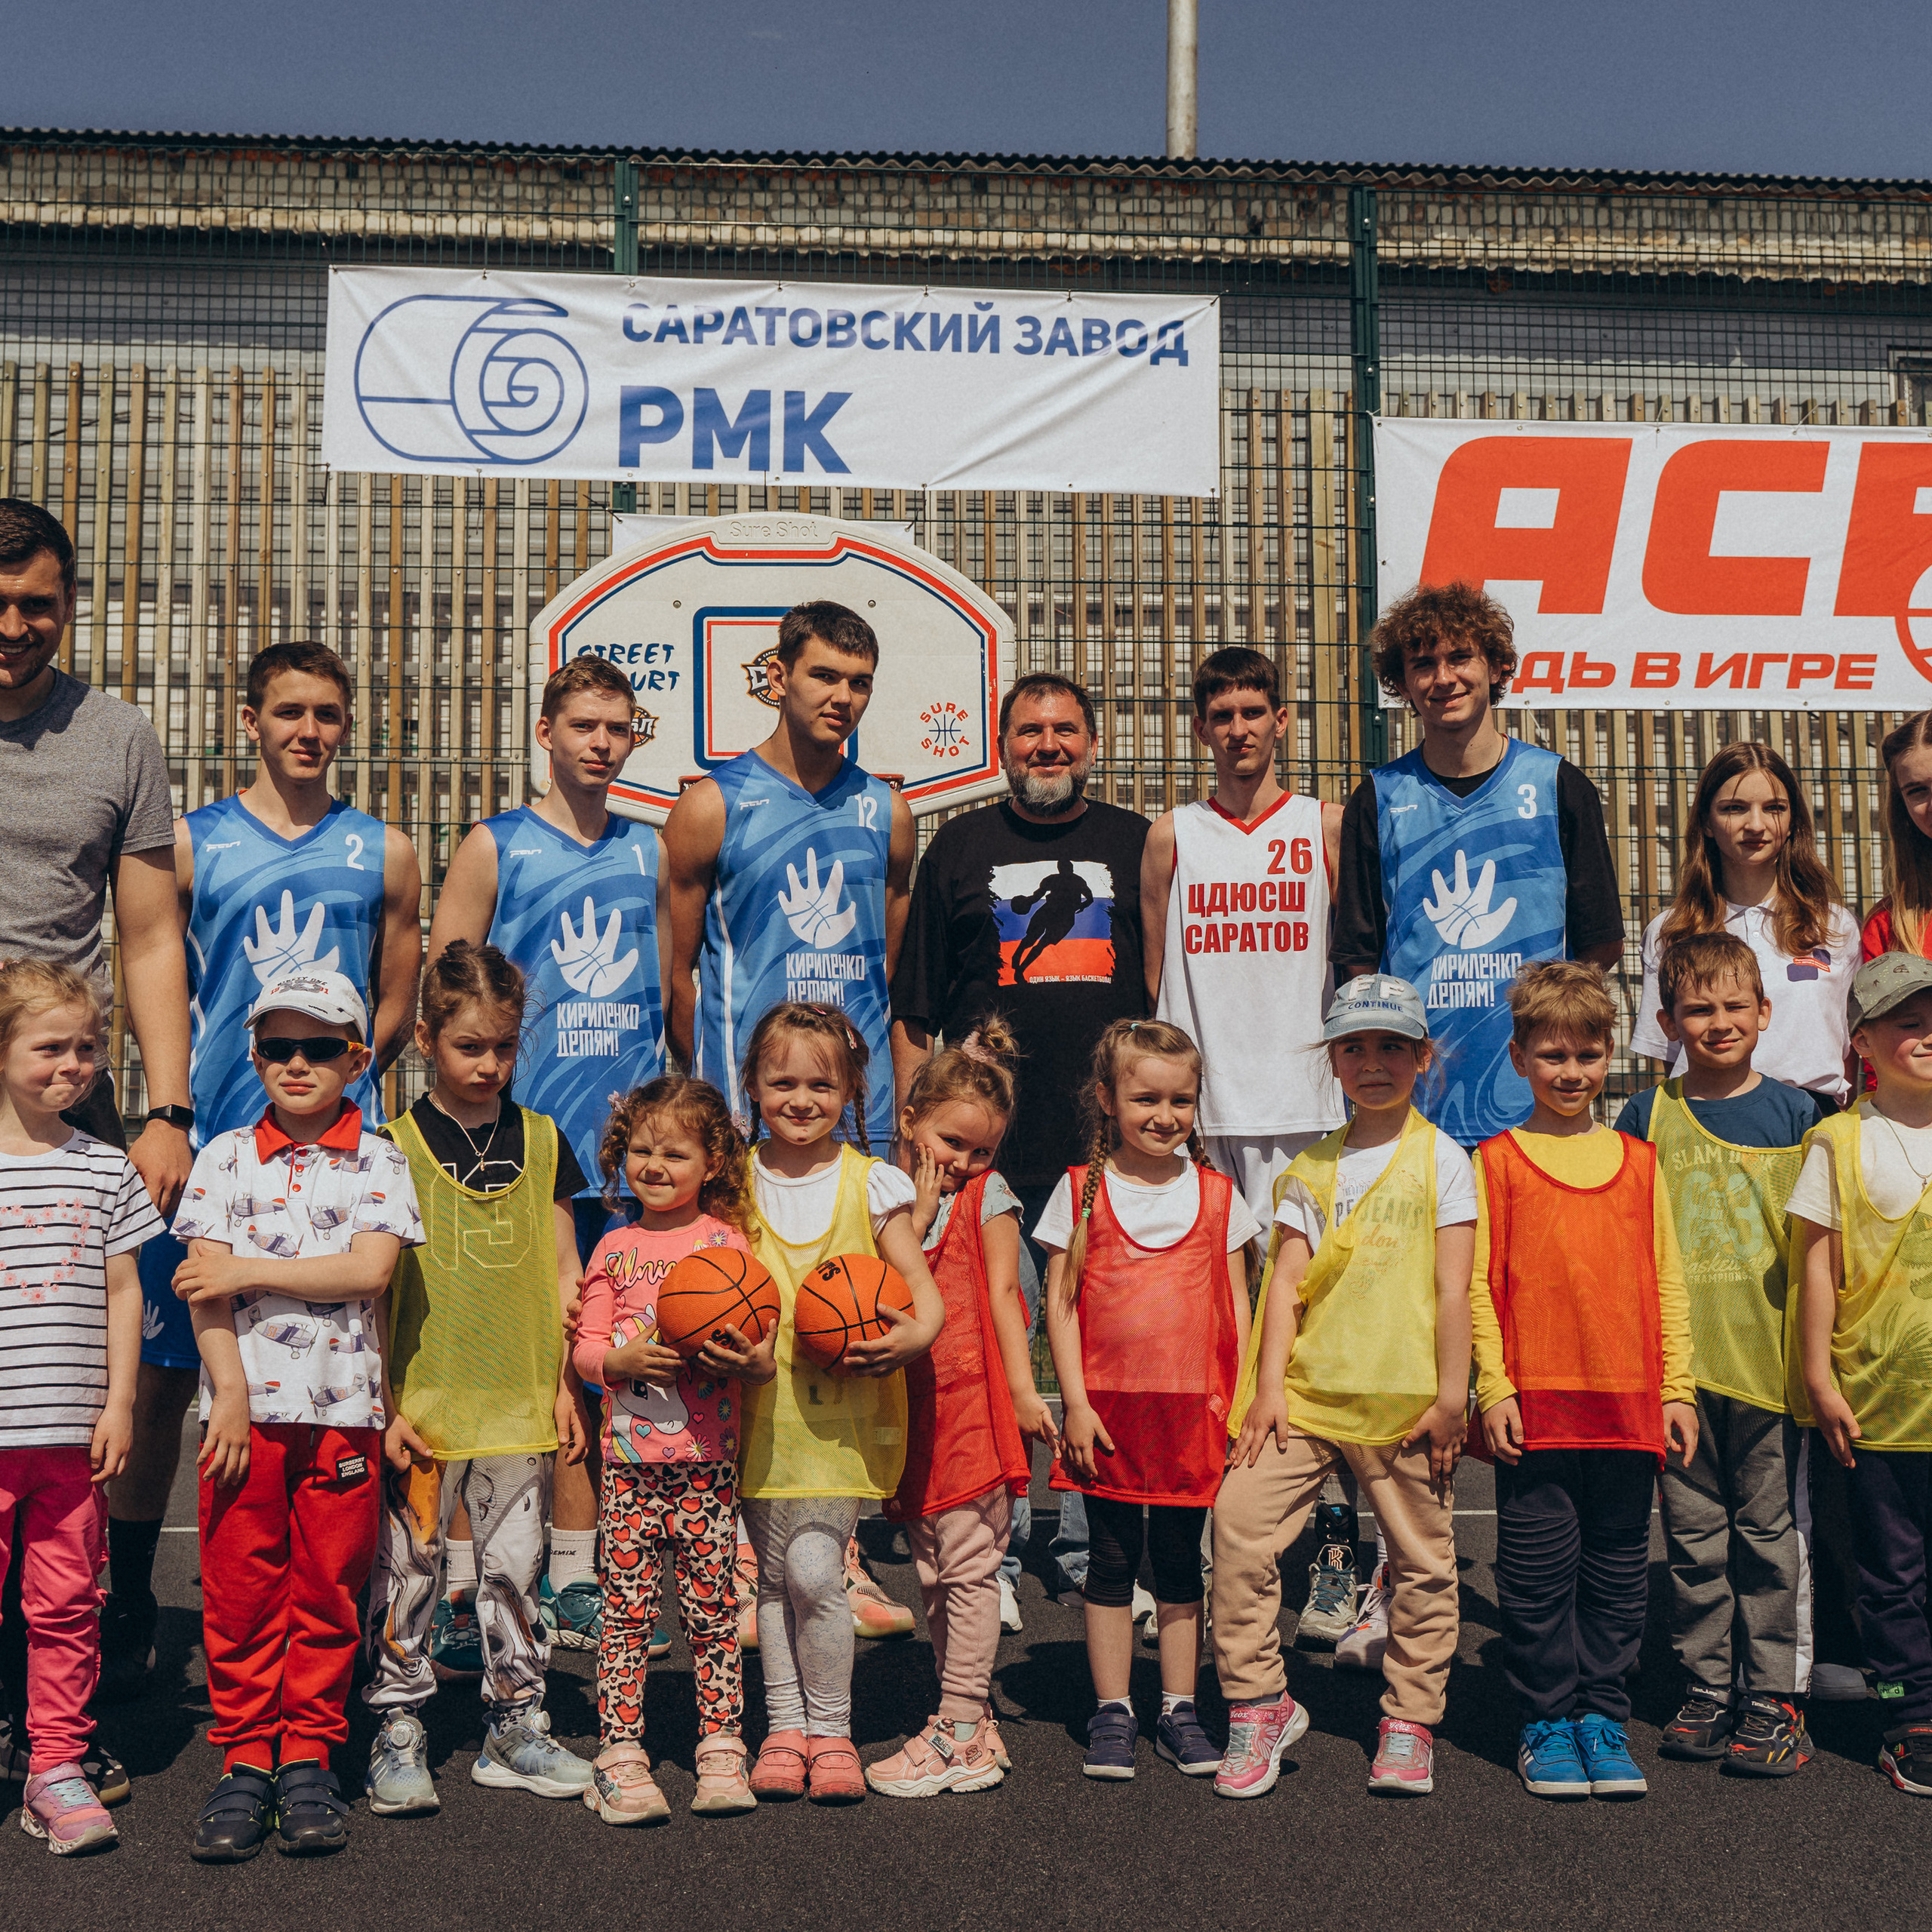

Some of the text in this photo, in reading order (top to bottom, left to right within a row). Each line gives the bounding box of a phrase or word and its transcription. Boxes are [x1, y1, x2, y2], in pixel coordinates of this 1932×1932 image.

[622, 301, 1189, 366] САРАТОВСКИЙ ЗАВОД
[619, 385, 852, 474] РМК
[730, 521, 818, 537] Sure Shot
[630, 670, 680, 691] URT
[1511, 651, 1878, 694] ДЬ В ИГРЕ
[919, 702, 969, 724] SURE
[920, 735, 970, 758] SHOT
[854, 793, 878, 832] 12
[1517, 783, 1537, 820] 3
[344, 833, 365, 871] 2
[631, 843, 646, 876] 1
[1267, 838, 1312, 875] 26
[1188, 881, 1306, 918] ЦДЮСШ
[1185, 921, 1309, 955] САРАТОВ
[1348, 1000, 1404, 1013] CONTINUE
[1672, 1144, 1722, 1171] SLAM
[339, 1457, 365, 1469] BURBERRY
[341, 1467, 365, 1478] ENGLAND
[342, 1463, 363, 1472] LONDON
